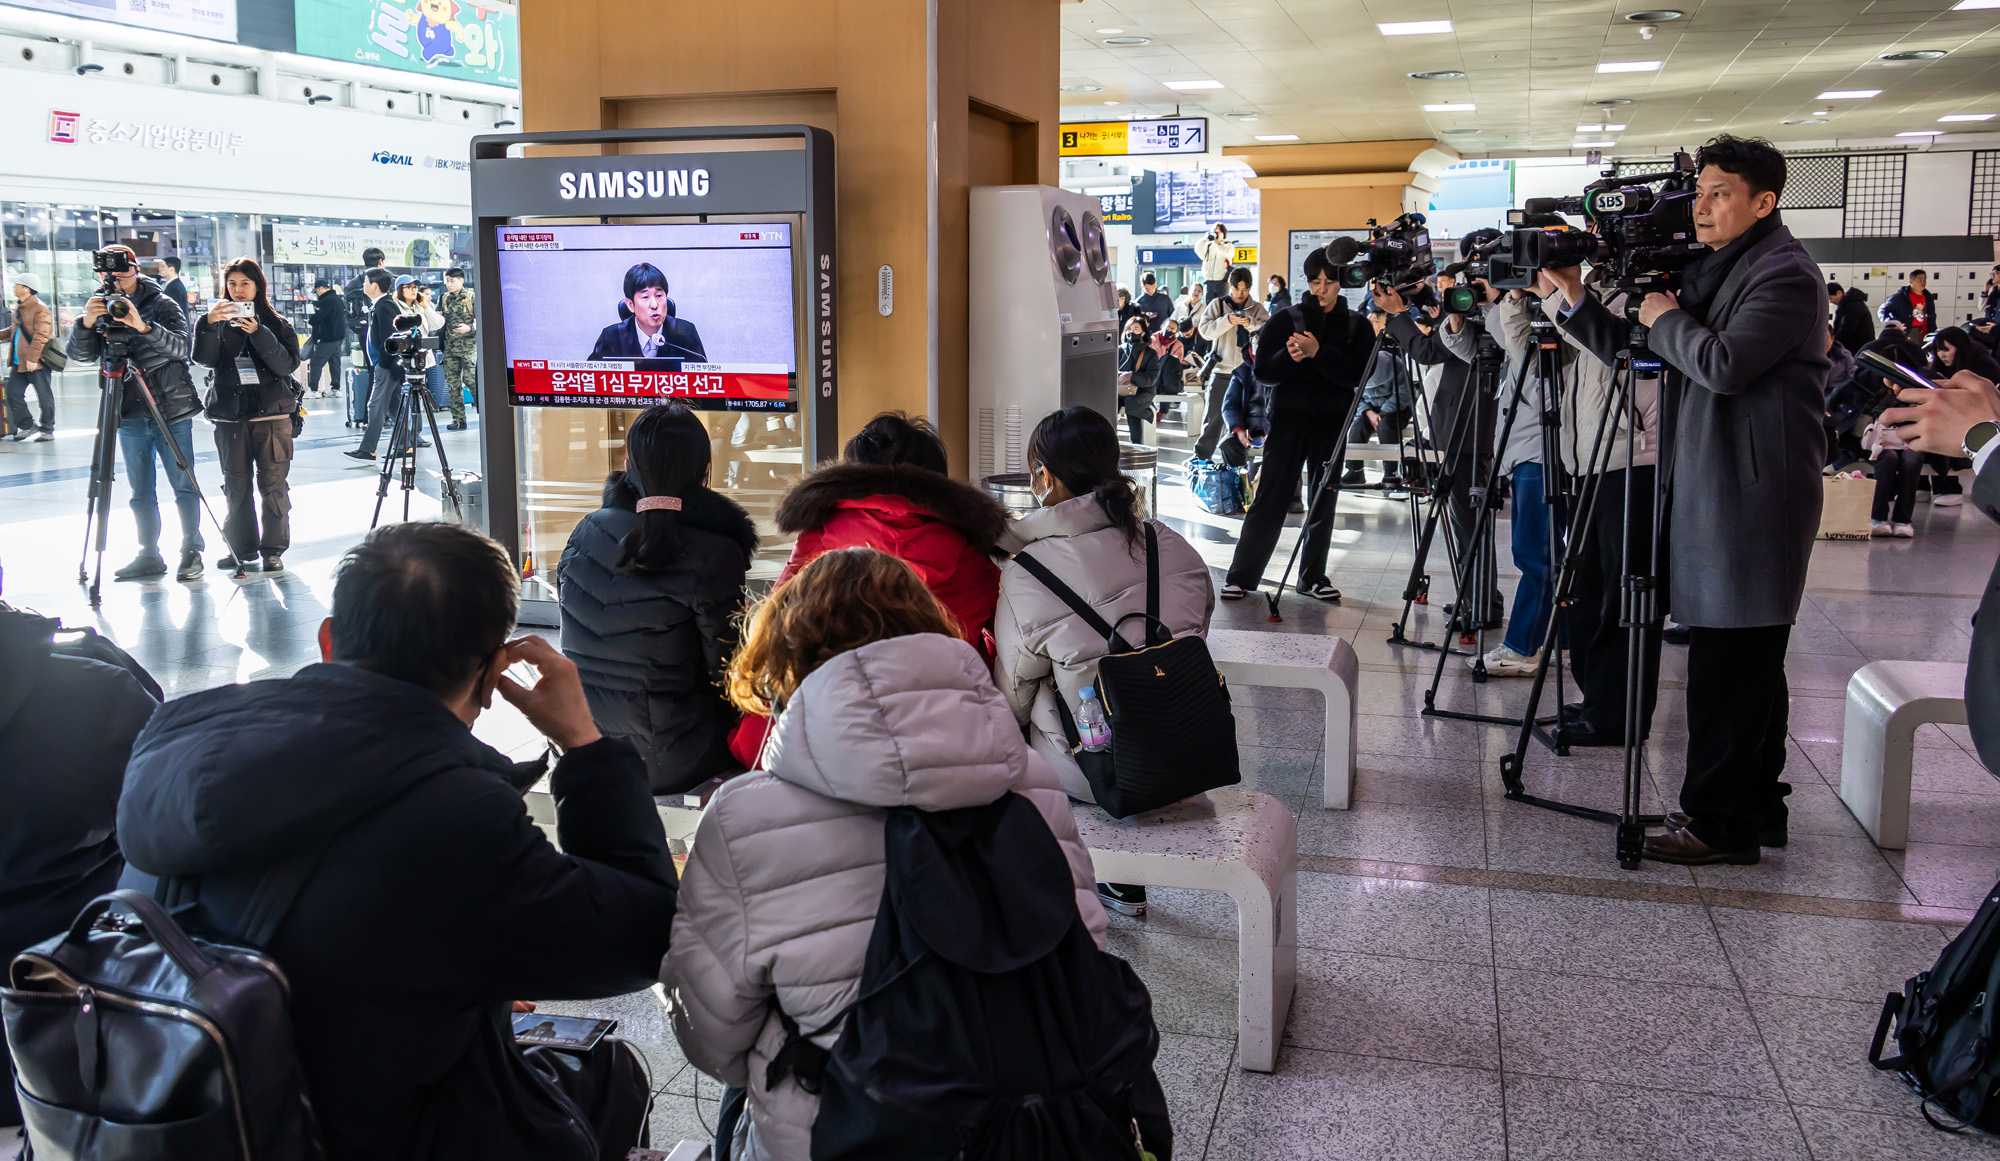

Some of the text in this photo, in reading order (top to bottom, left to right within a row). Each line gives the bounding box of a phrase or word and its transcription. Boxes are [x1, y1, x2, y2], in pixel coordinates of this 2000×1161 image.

[88, 118, 247, 156] 중소기업명품마루
[1066, 134, 1074, 146] 3
[1080, 132, 1098, 140] 나가는
[372, 150, 414, 166] KORAIL
[435, 158, 448, 168] IBK
[560, 168, 710, 200] SAMSUNG
[1598, 195, 1624, 208] SBS
[761, 232, 782, 240] YTN
[304, 236, 356, 257] 설 기획전
[1388, 240, 1403, 249] KBS
[1240, 251, 1246, 260] 3
[820, 254, 832, 398] SAMSUNG
[551, 372, 725, 395] 윤석열 1심 무기징역 선고
